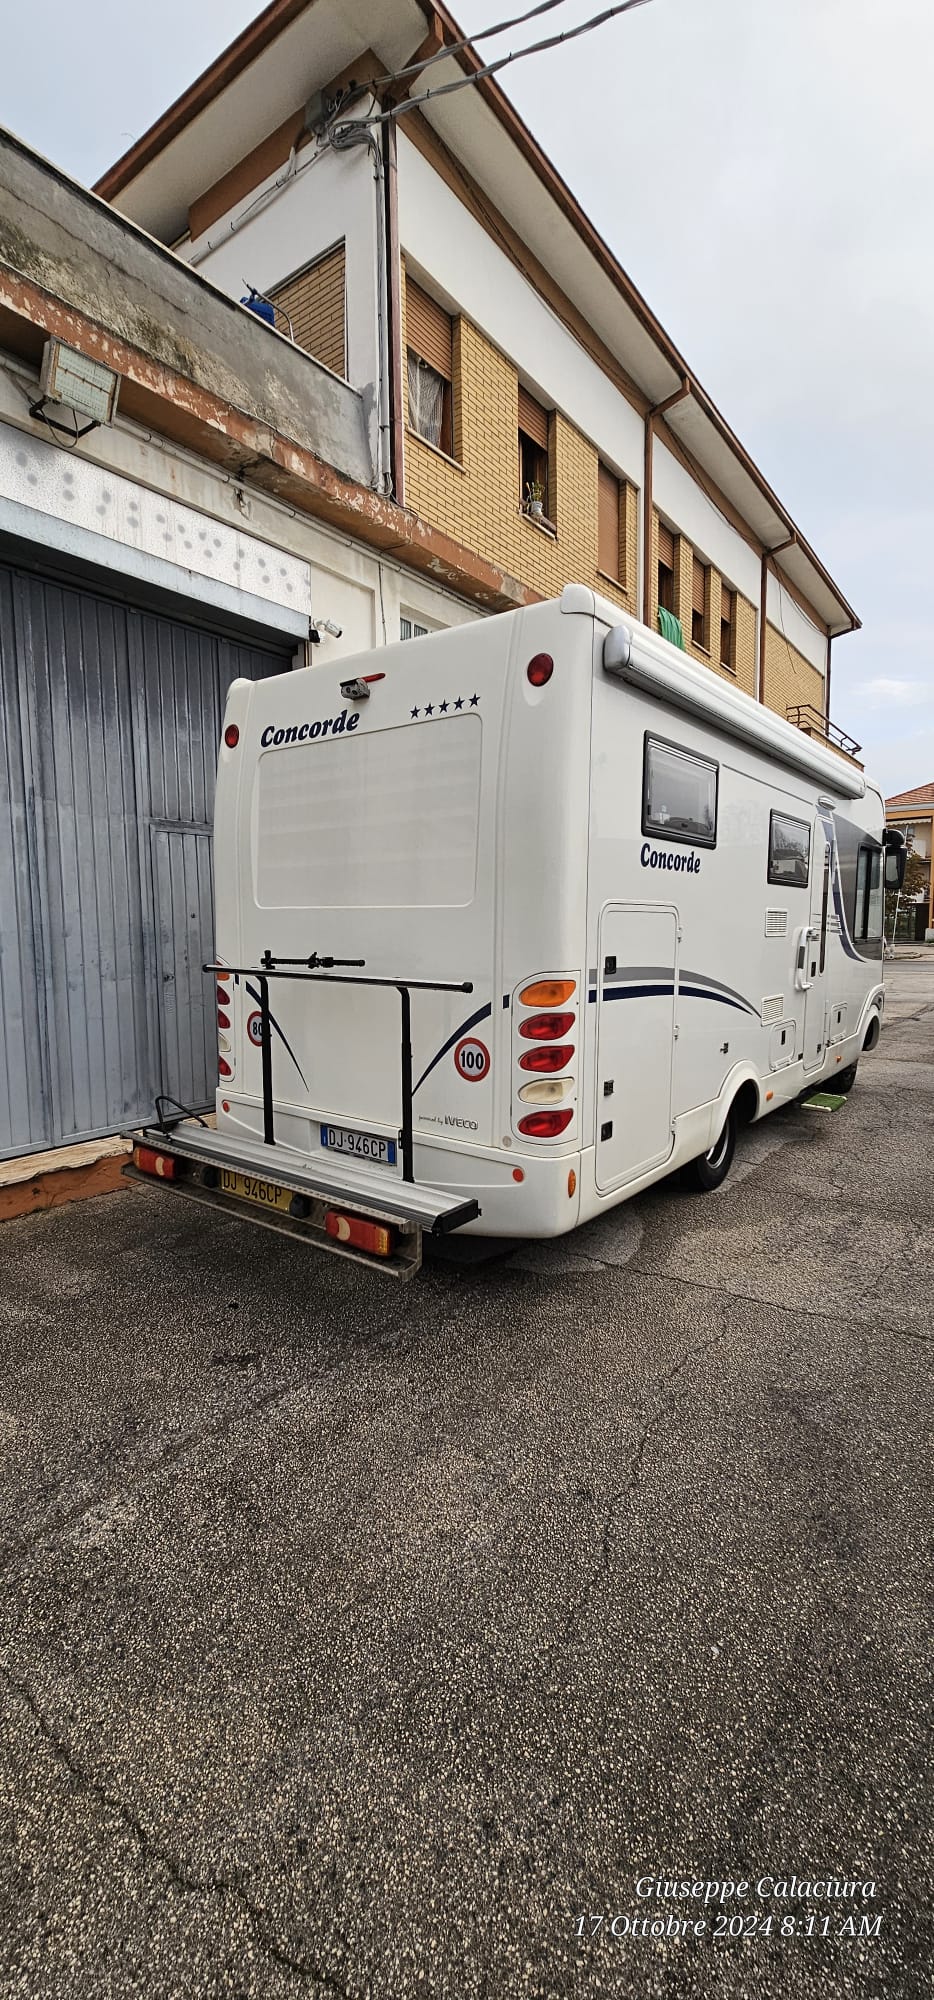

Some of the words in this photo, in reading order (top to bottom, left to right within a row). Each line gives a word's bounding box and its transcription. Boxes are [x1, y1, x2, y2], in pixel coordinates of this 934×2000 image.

[261, 709, 360, 748] Concorde
[640, 842, 701, 874] Concorde
[460, 1050, 484, 1070] 100
[444, 1114, 479, 1130] IVECO
